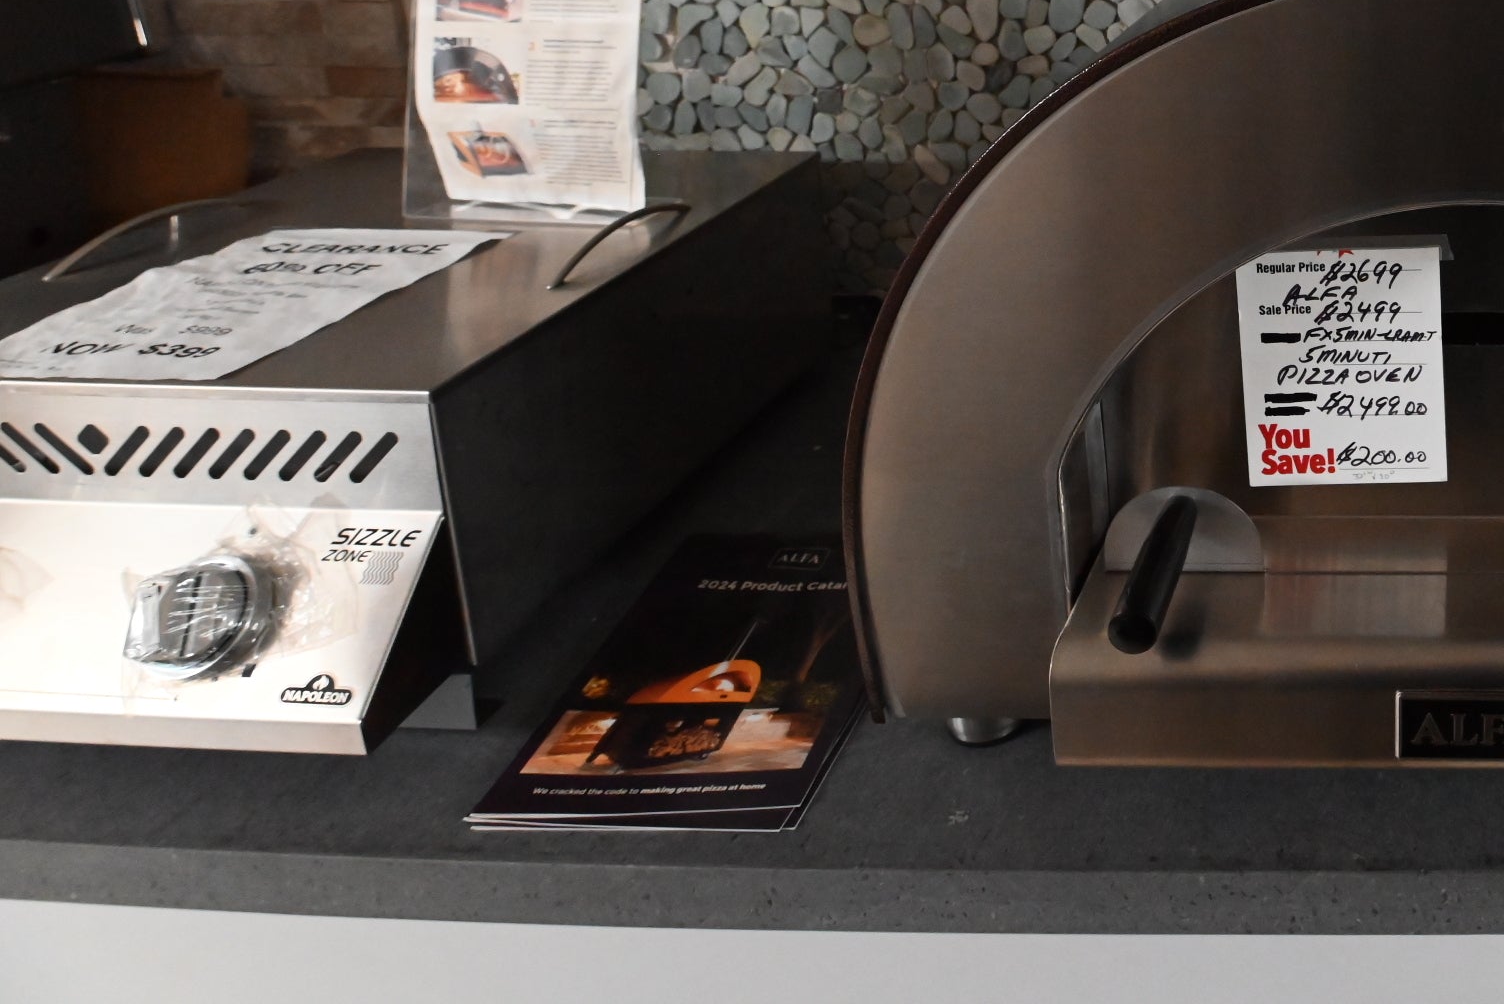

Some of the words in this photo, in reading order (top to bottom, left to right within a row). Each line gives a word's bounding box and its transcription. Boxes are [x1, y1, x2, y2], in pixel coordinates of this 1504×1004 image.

[262, 243, 448, 255] CLEARANCE
[313, 263, 383, 275] OFF
[1256, 263, 1296, 274] Regular
[1299, 263, 1326, 273] Price
[1320, 259, 1403, 289] $2699
[1283, 284, 1358, 307] ALFA
[1259, 305, 1283, 316] Sale
[1285, 304, 1311, 315] Price
[1314, 301, 1401, 325] $2499
[44, 341, 134, 355] NOW
[138, 343, 220, 358] $399
[1277, 365, 1349, 385] PIZZA
[1355, 365, 1423, 383] OVEN
[1258, 424, 1311, 450] You
[1261, 448, 1336, 475] Save!
[1336, 442, 1426, 466] $200.00
[331, 528, 422, 547] SIZZLE
[321, 549, 372, 563] ZONE
[698, 580, 737, 590] 2024
[741, 581, 803, 591] Product
[282, 690, 349, 703] NAPOLEON
[640, 786, 676, 795] making
[675, 786, 702, 794] great
[702, 785, 727, 793] pizza
